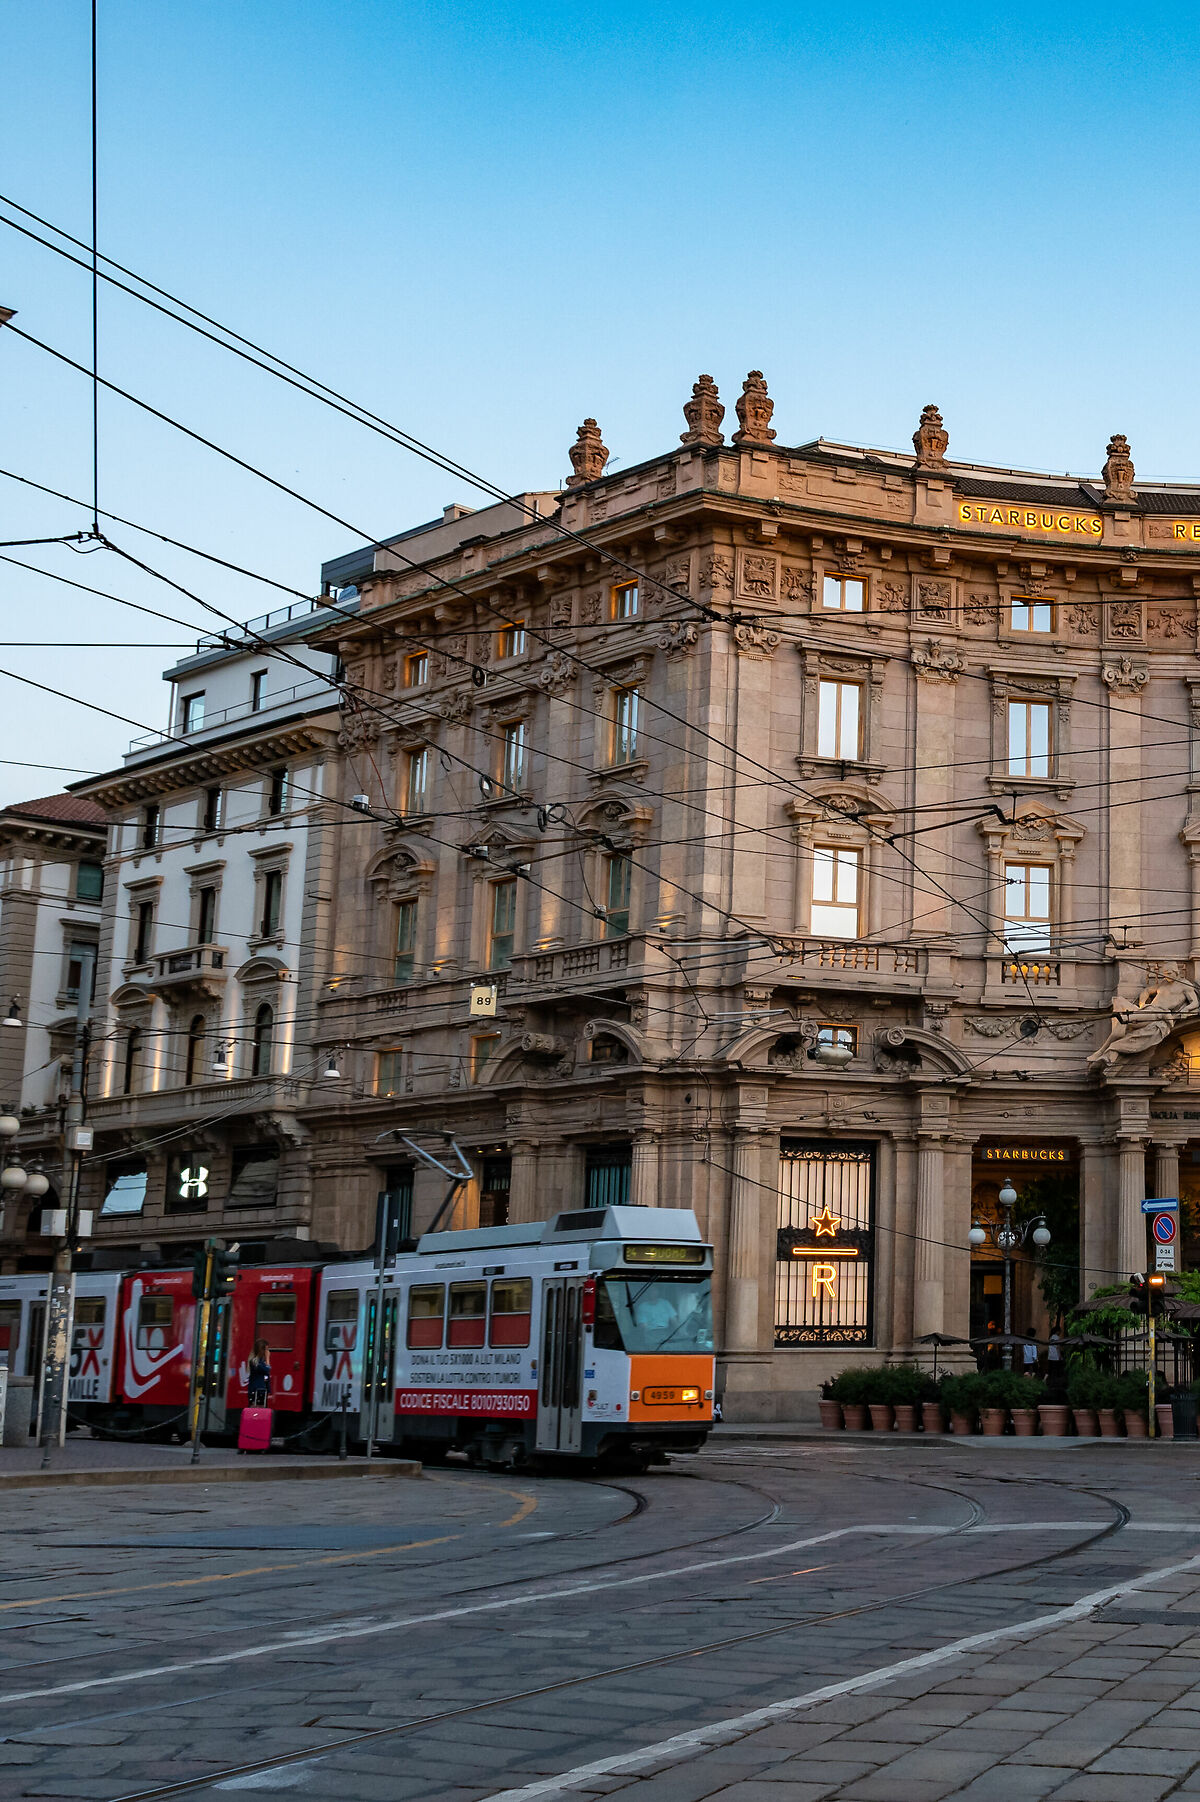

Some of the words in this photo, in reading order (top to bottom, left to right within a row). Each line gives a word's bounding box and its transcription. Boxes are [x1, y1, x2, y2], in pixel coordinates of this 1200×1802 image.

[961, 505, 1102, 533] STARBUCKS
[476, 996, 491, 1006] 89
[986, 1148, 1065, 1161] STARBUCKS
[811, 1264, 837, 1298] R
[399, 1393, 432, 1408] CODICE
[433, 1393, 469, 1410] FISCALE
[470, 1394, 530, 1411] 80107930150
[650, 1391, 675, 1400] 4959
